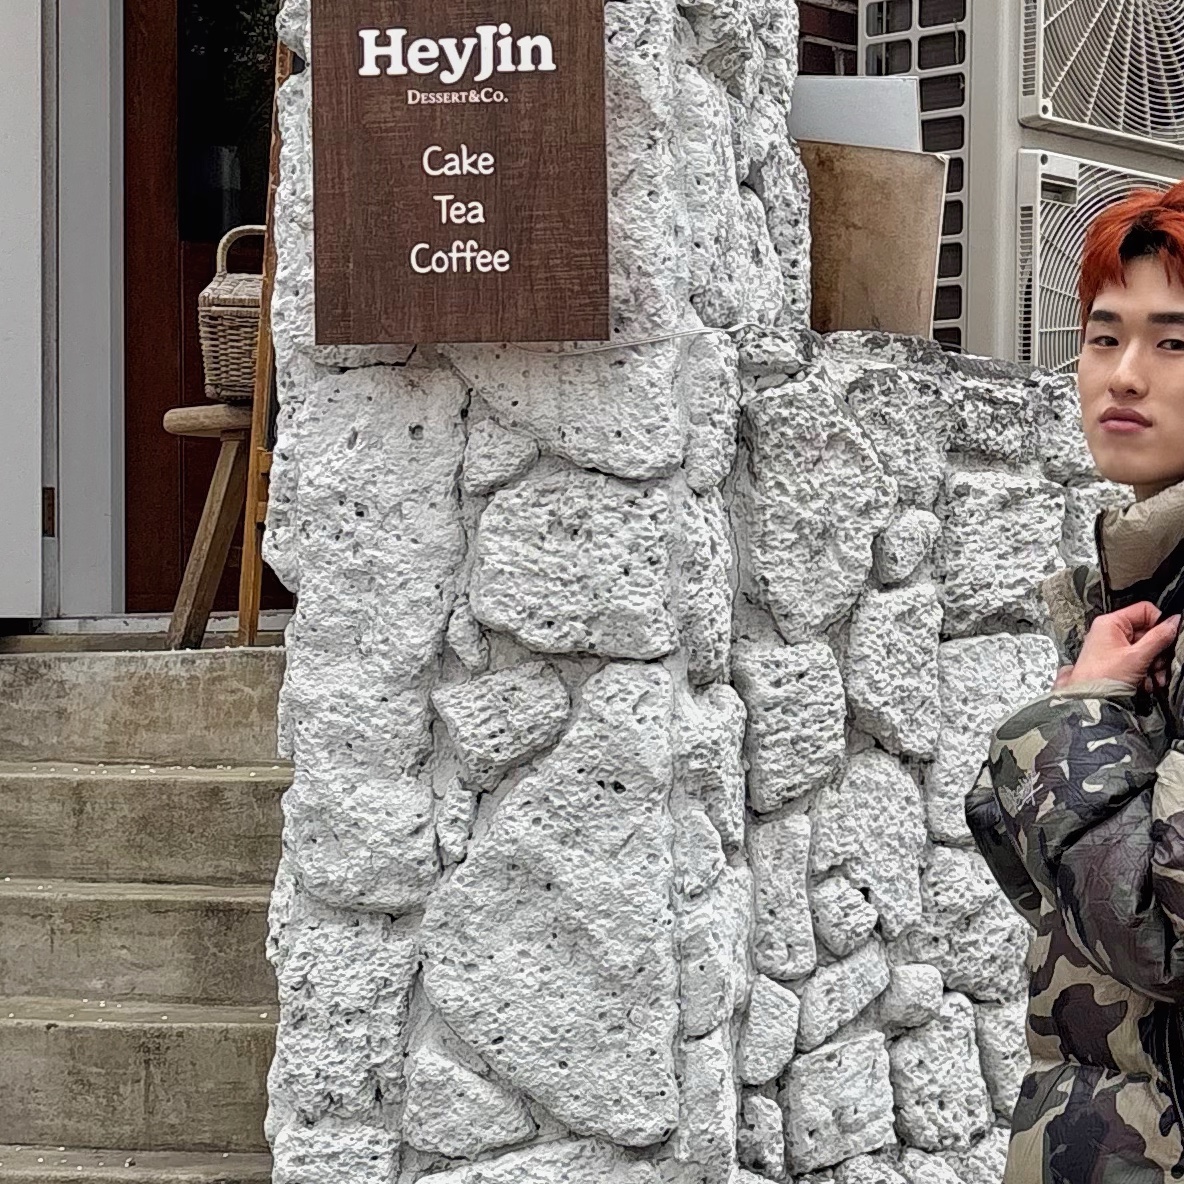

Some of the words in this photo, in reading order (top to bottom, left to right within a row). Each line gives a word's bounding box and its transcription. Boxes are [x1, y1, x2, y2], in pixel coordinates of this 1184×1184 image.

[358, 23, 556, 84] HeyJin
[422, 144, 495, 176] Cake
[433, 194, 485, 224] Tea
[410, 240, 510, 273] Coffee
